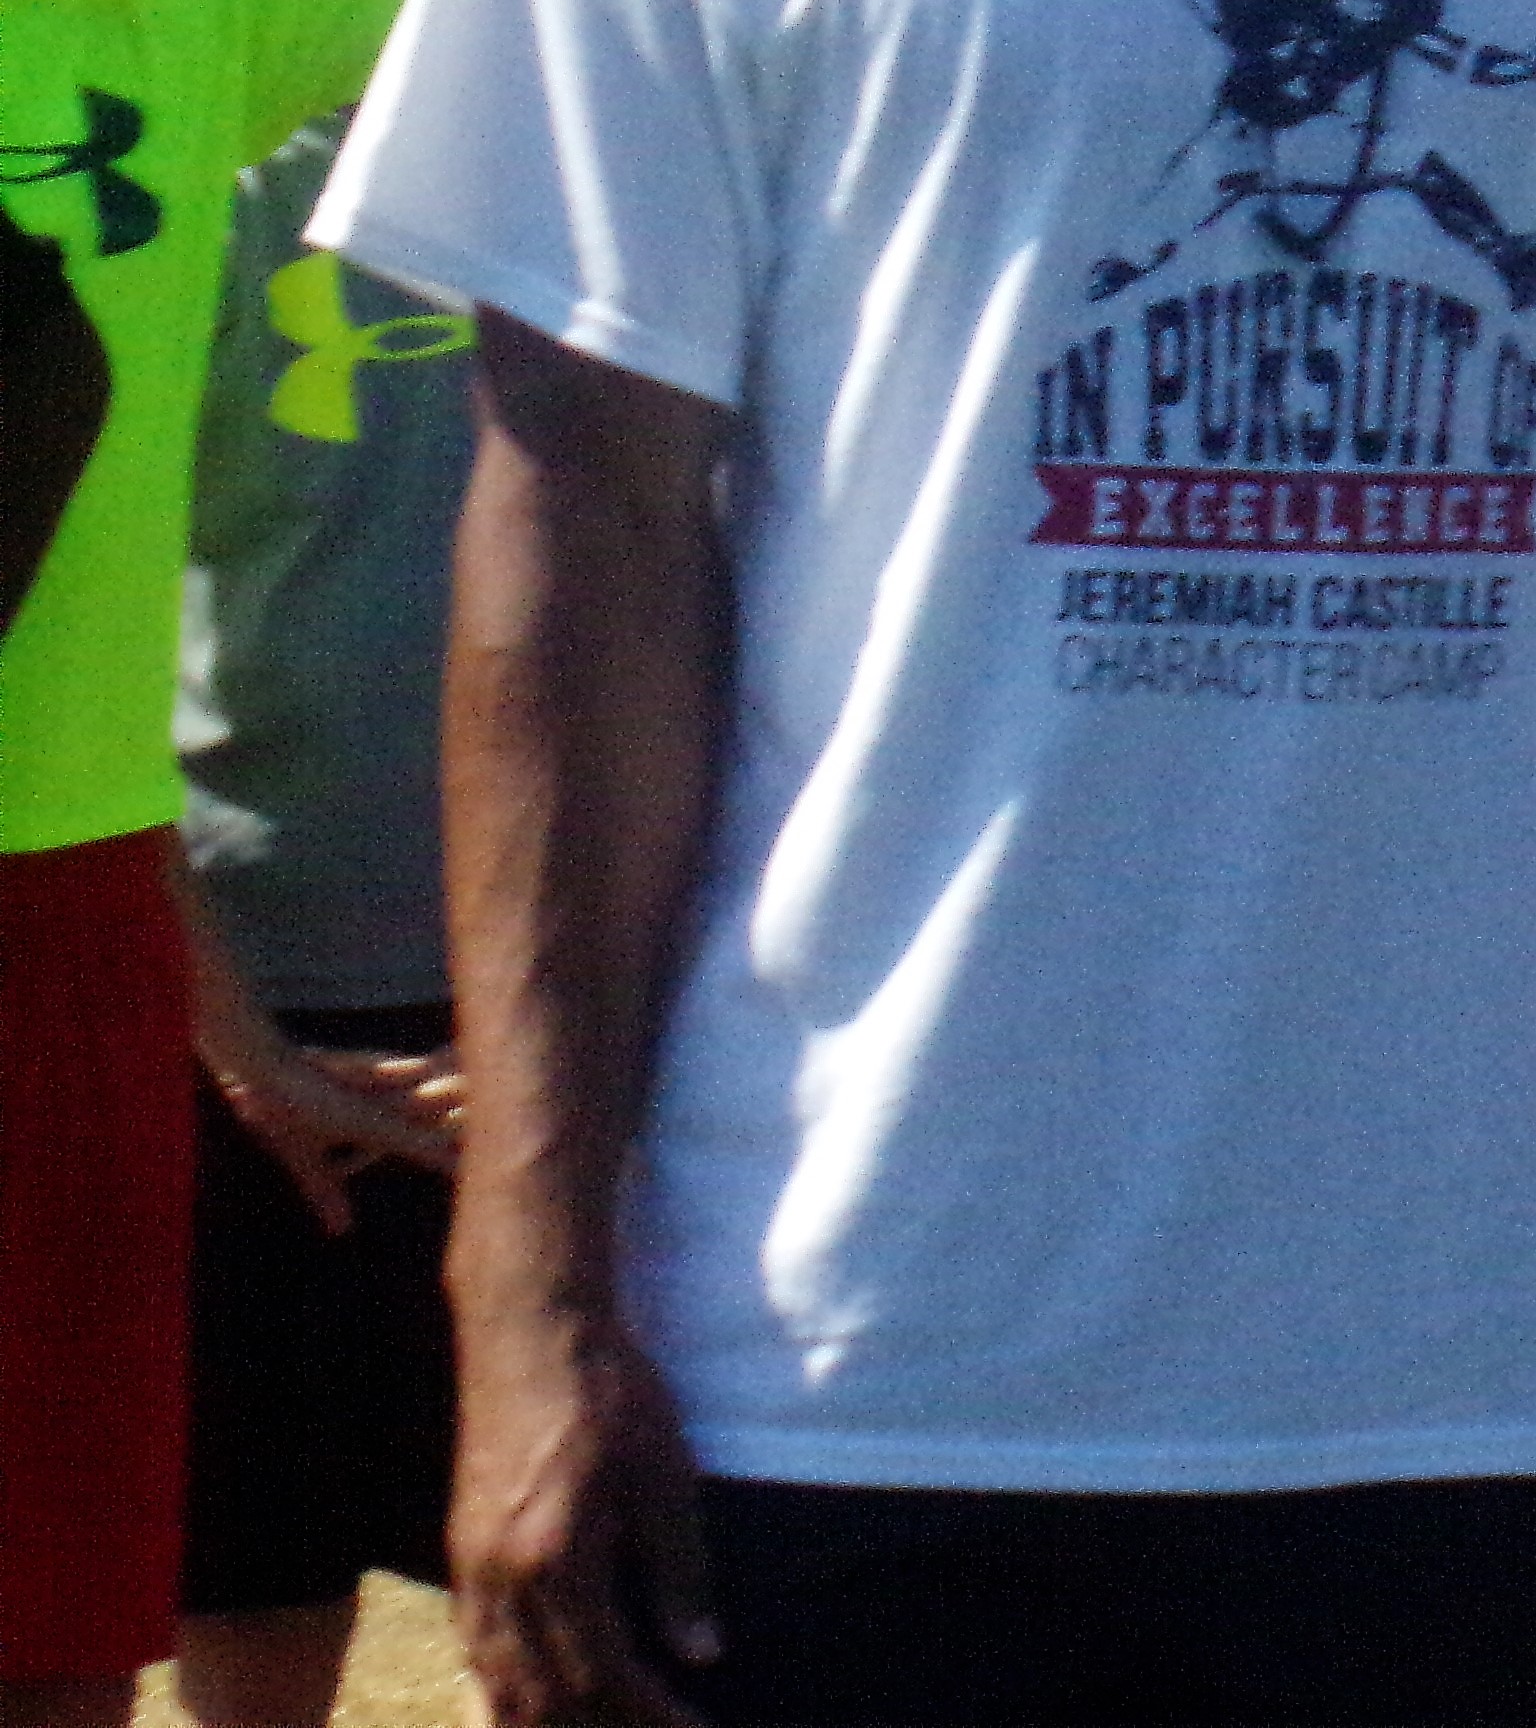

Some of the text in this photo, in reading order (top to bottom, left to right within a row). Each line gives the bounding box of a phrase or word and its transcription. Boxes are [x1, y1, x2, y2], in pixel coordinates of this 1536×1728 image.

[1034, 325, 1113, 459] IN
[1143, 268, 1481, 466] PURSUIT
[1091, 475, 1512, 545] EXCELLENCE
[1056, 568, 1515, 630] JEREMIAH CASTILLE
[1054, 634, 1507, 703] CHARACTER CAMP
